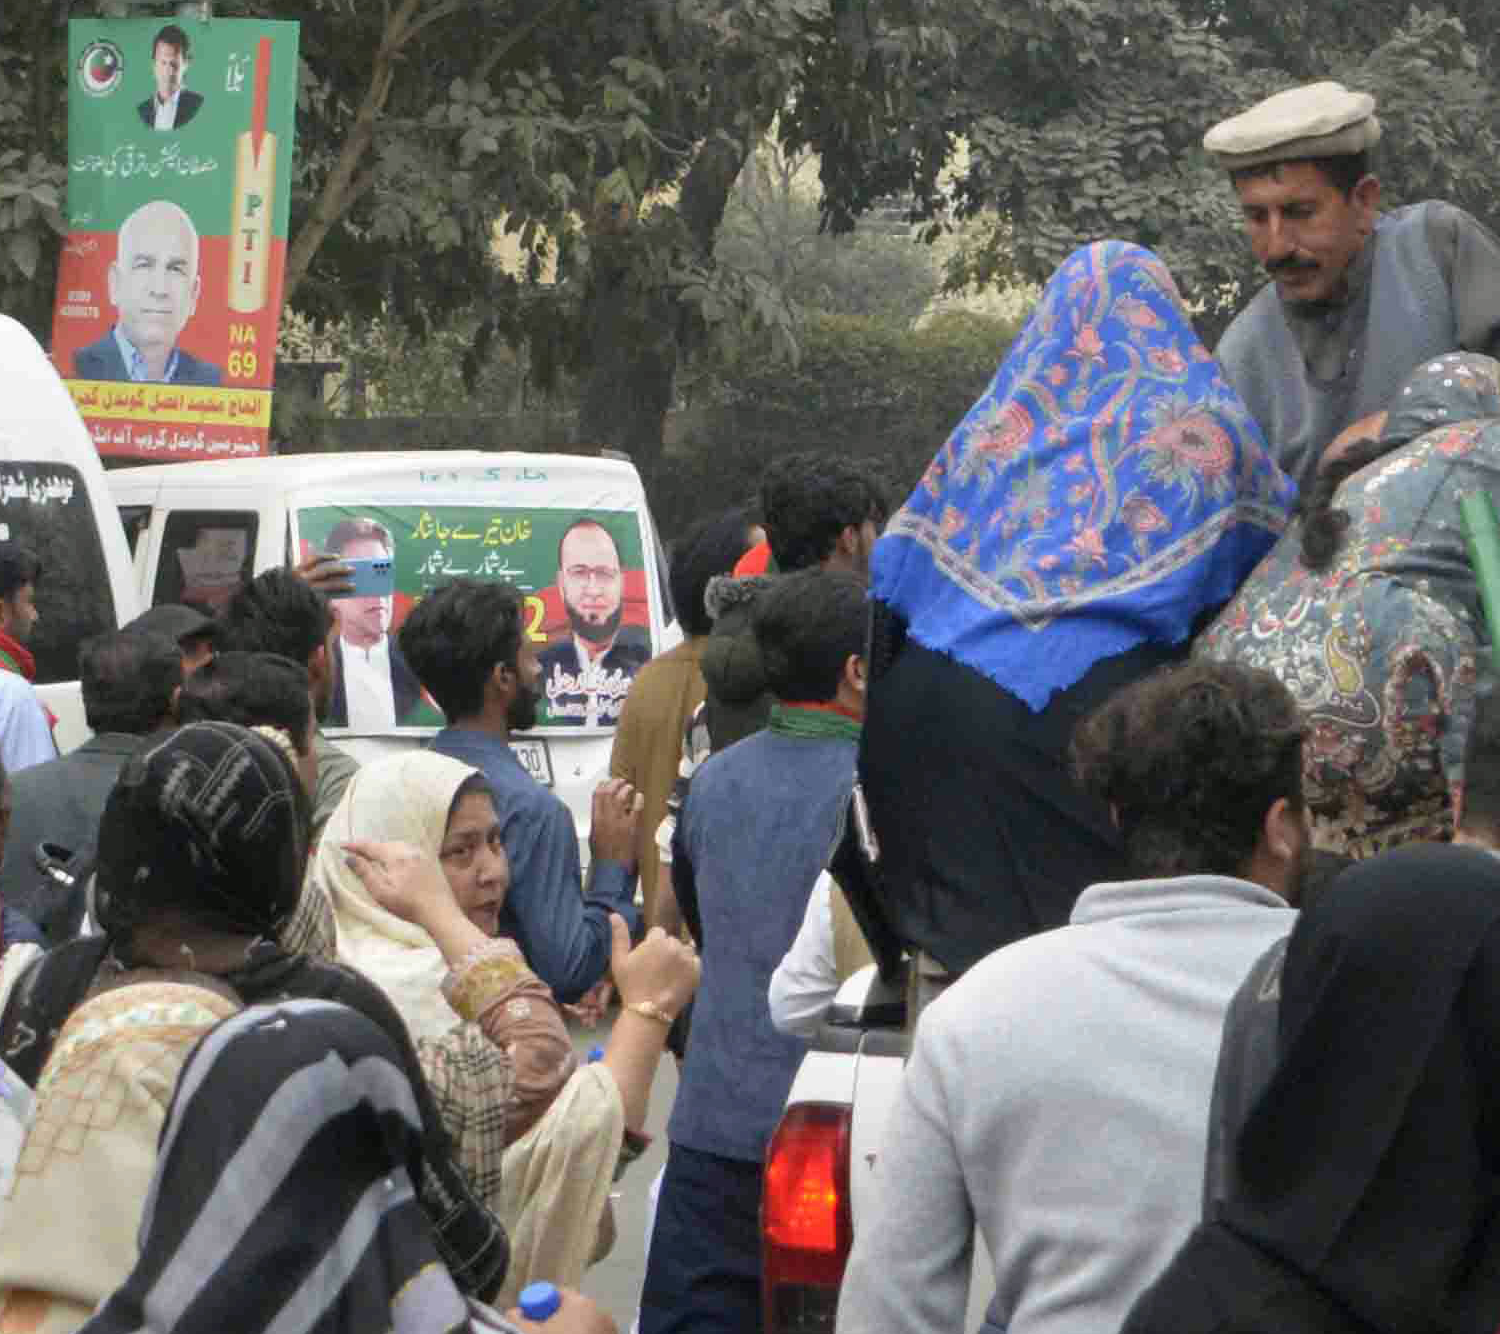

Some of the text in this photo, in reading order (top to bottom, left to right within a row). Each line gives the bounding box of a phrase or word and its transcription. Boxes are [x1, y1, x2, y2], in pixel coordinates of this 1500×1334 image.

[228, 324, 257, 344] NA
[227, 350, 258, 379] 69
[501, 518, 532, 544] خان
